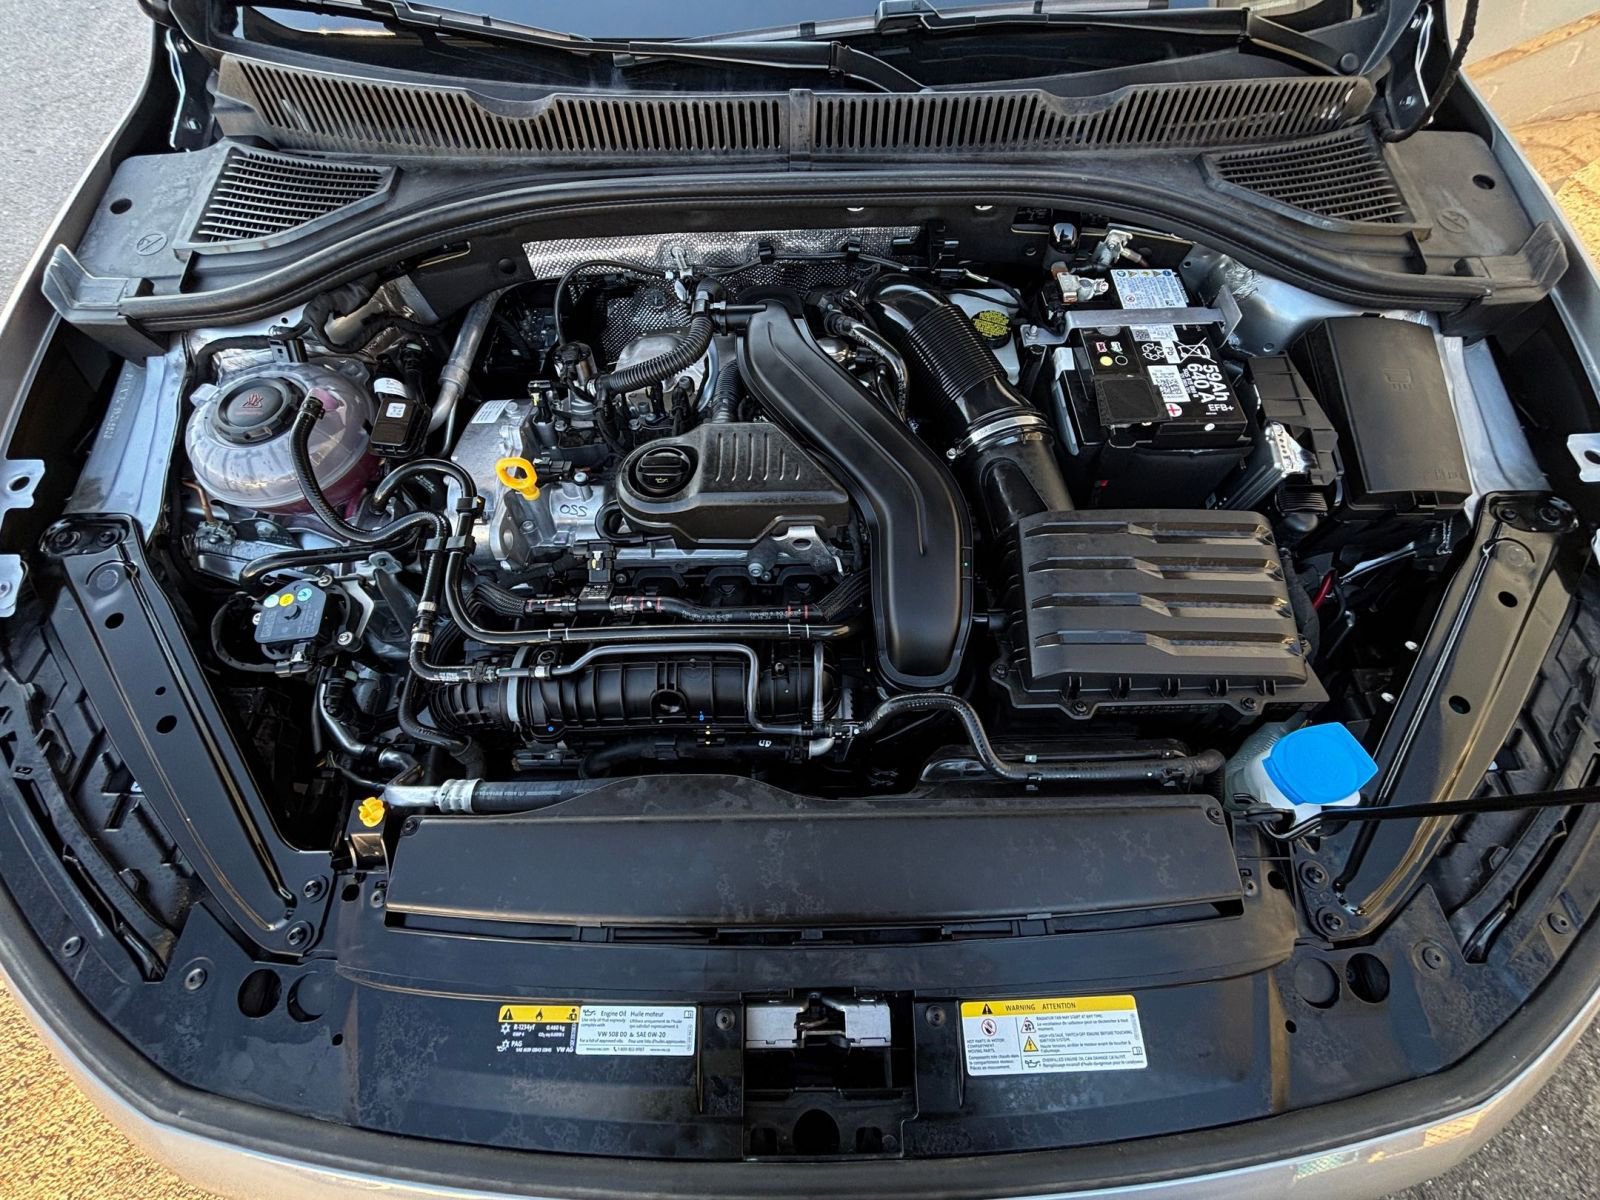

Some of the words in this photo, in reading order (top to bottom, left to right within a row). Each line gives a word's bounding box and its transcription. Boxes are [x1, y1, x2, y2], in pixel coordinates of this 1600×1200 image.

[1187, 363, 1210, 389] 640
[1202, 364, 1230, 401] 59Ah
[1198, 392, 1216, 403] A
[1208, 404, 1234, 412] EFB+
[1006, 1004, 1036, 1012] WARNING
[1042, 1002, 1076, 1010] ATTENTION
